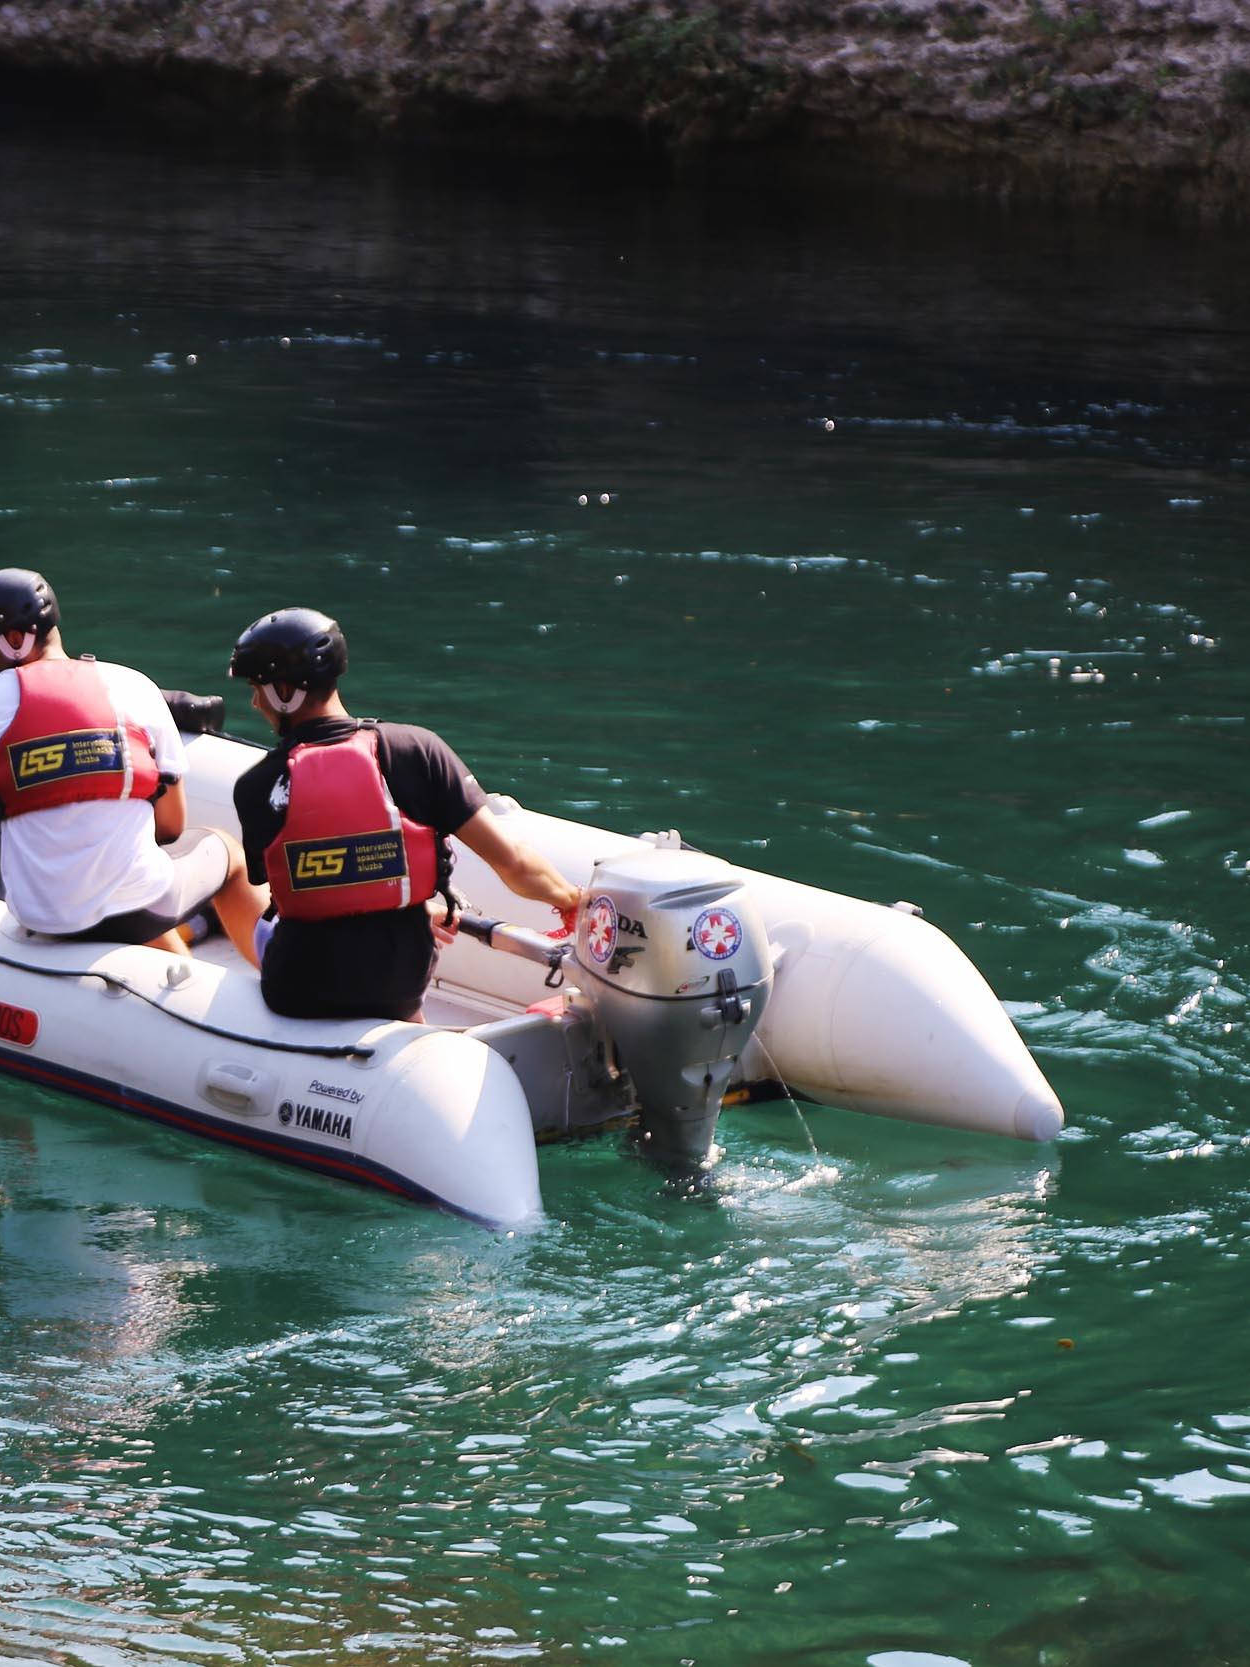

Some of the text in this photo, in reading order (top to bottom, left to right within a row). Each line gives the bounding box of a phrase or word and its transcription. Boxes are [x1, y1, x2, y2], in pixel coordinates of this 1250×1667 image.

[310, 1079, 365, 1104] Powered by
[295, 1104, 353, 1140] YAMAHA
